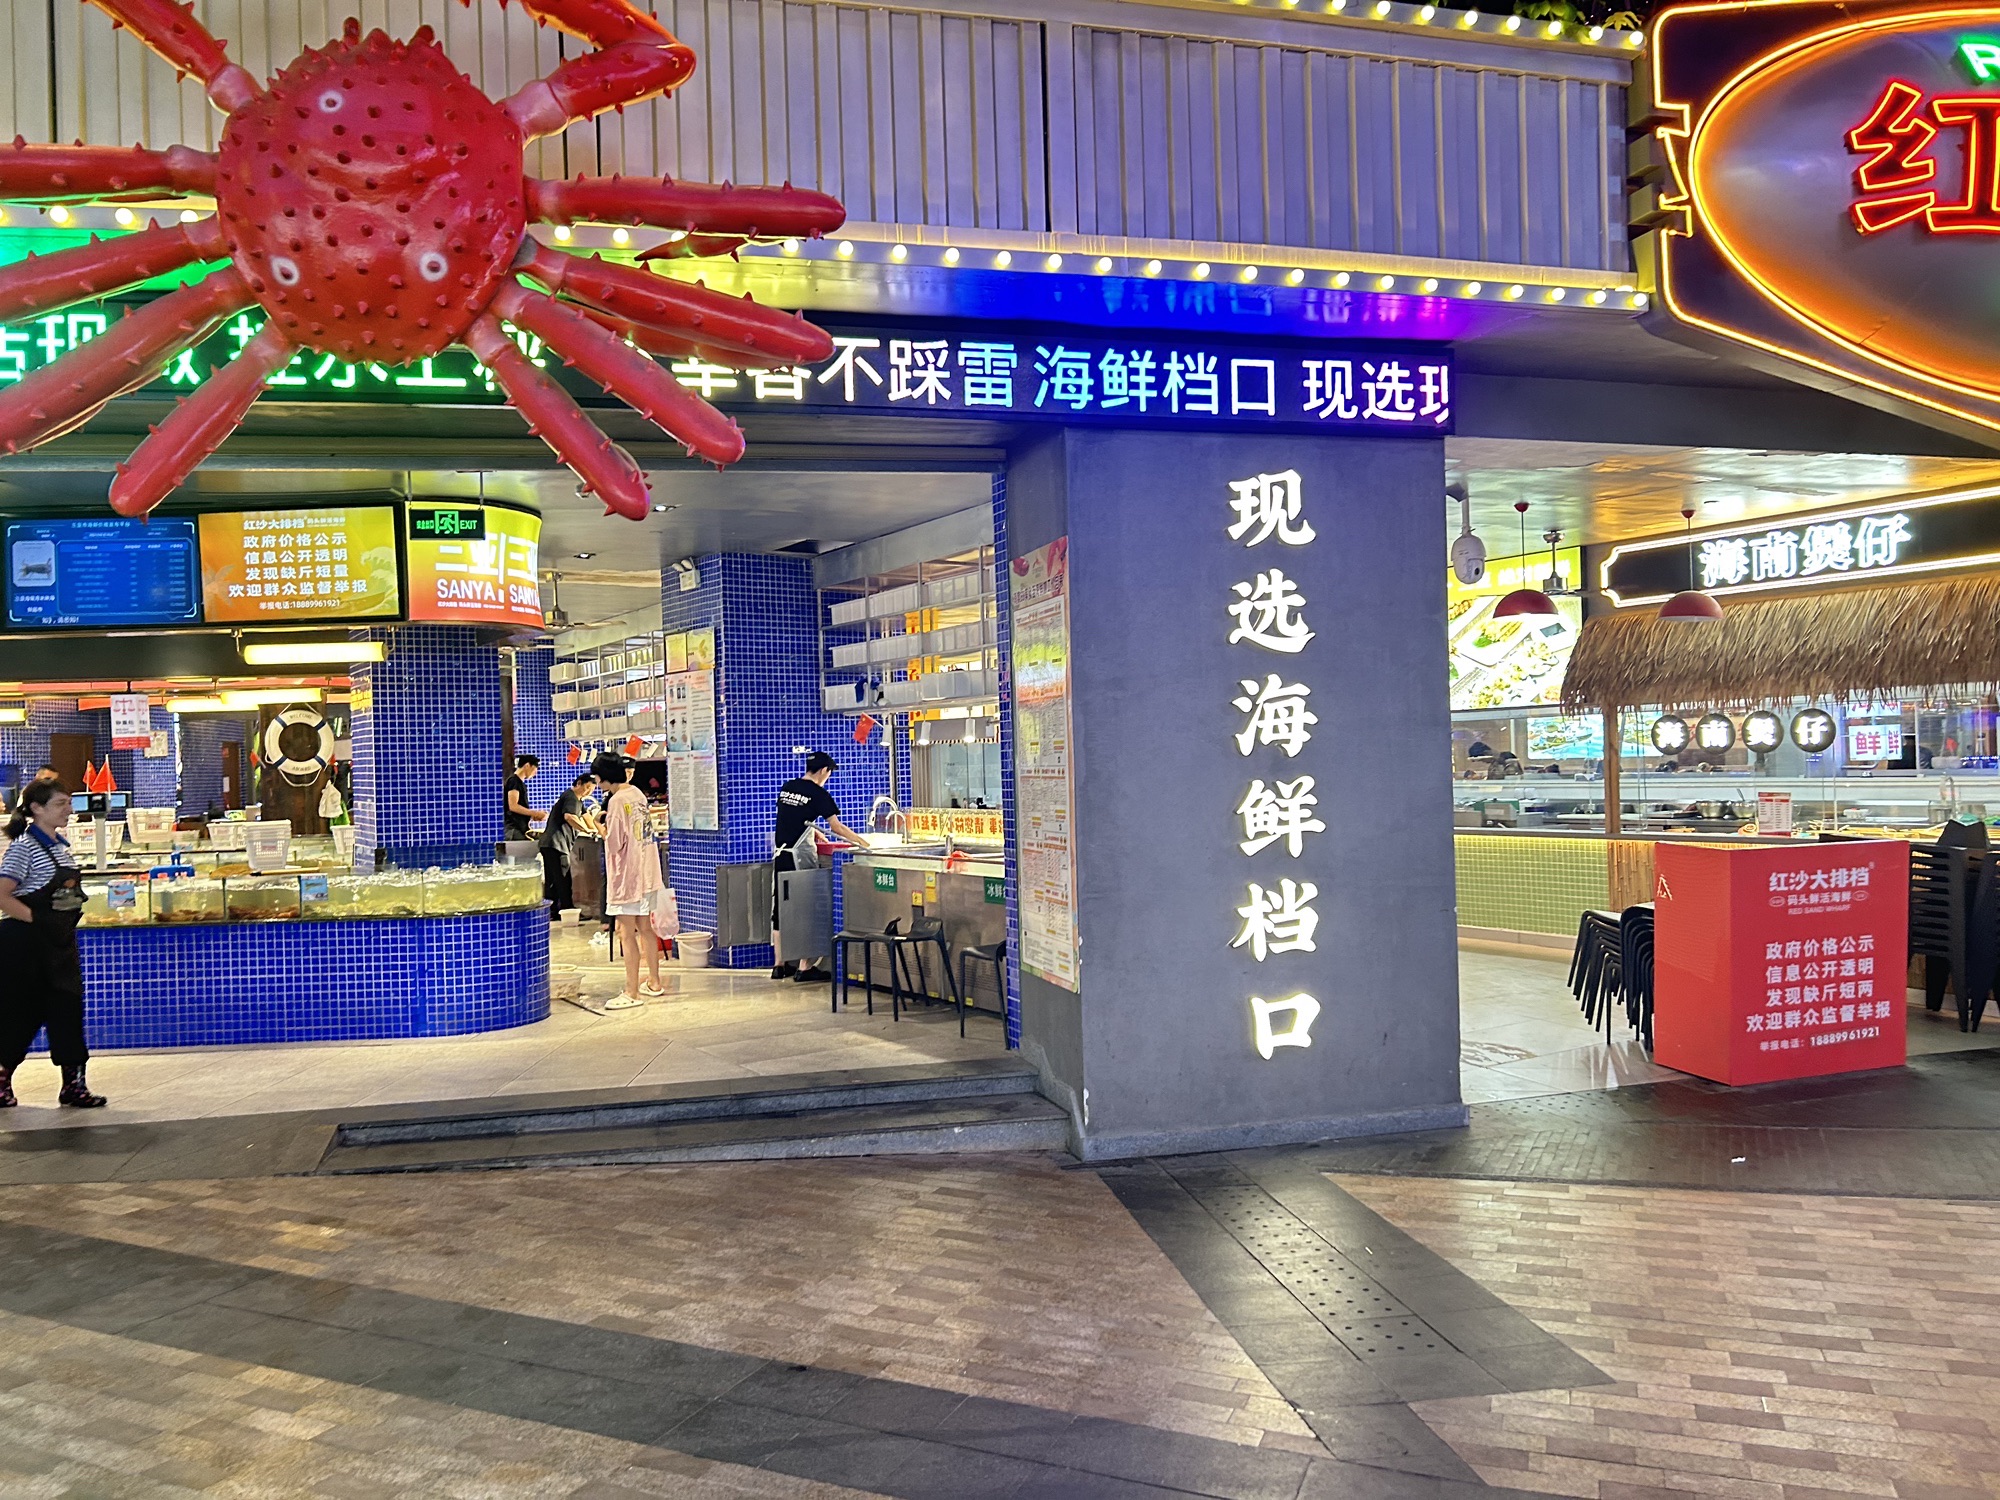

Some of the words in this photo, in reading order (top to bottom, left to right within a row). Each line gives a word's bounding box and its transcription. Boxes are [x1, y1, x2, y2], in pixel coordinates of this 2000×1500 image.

[1849, 80, 2000, 235] 红
[1033, 344, 1277, 417] 海鲜档口
[243, 518, 305, 531] 红沙大排档
[460, 520, 478, 530] EXIT
[243, 532, 347, 549] 政府价格公示
[1698, 513, 1912, 588] 海南煲仔
[244, 548, 348, 565] 信息公开透明
[245, 564, 349, 581] 发现缺斤短量
[228, 579, 368, 598] 欢迎群众监督举报
[436, 578, 496, 602] SANYA
[289, 712, 313, 720] WELCOME
[1855, 731, 1881, 756] 鲜
[1226, 468, 1328, 1060] 现选海鲜档口
[876, 872, 895, 887] 冰鲜台
[1769, 867, 1870, 892] 红沙大排档
[1787, 891, 1852, 906] 码头鲜活海鲜
[1765, 934, 1875, 960] 政府价格公示
[1765, 957, 1875, 985] 信息公开透明
[1765, 979, 1874, 1008] 发现缺斤短两
[1746, 1000, 1891, 1033] 欢迎群众监督举报
[1809, 1026, 1880, 1047] 18889961921
